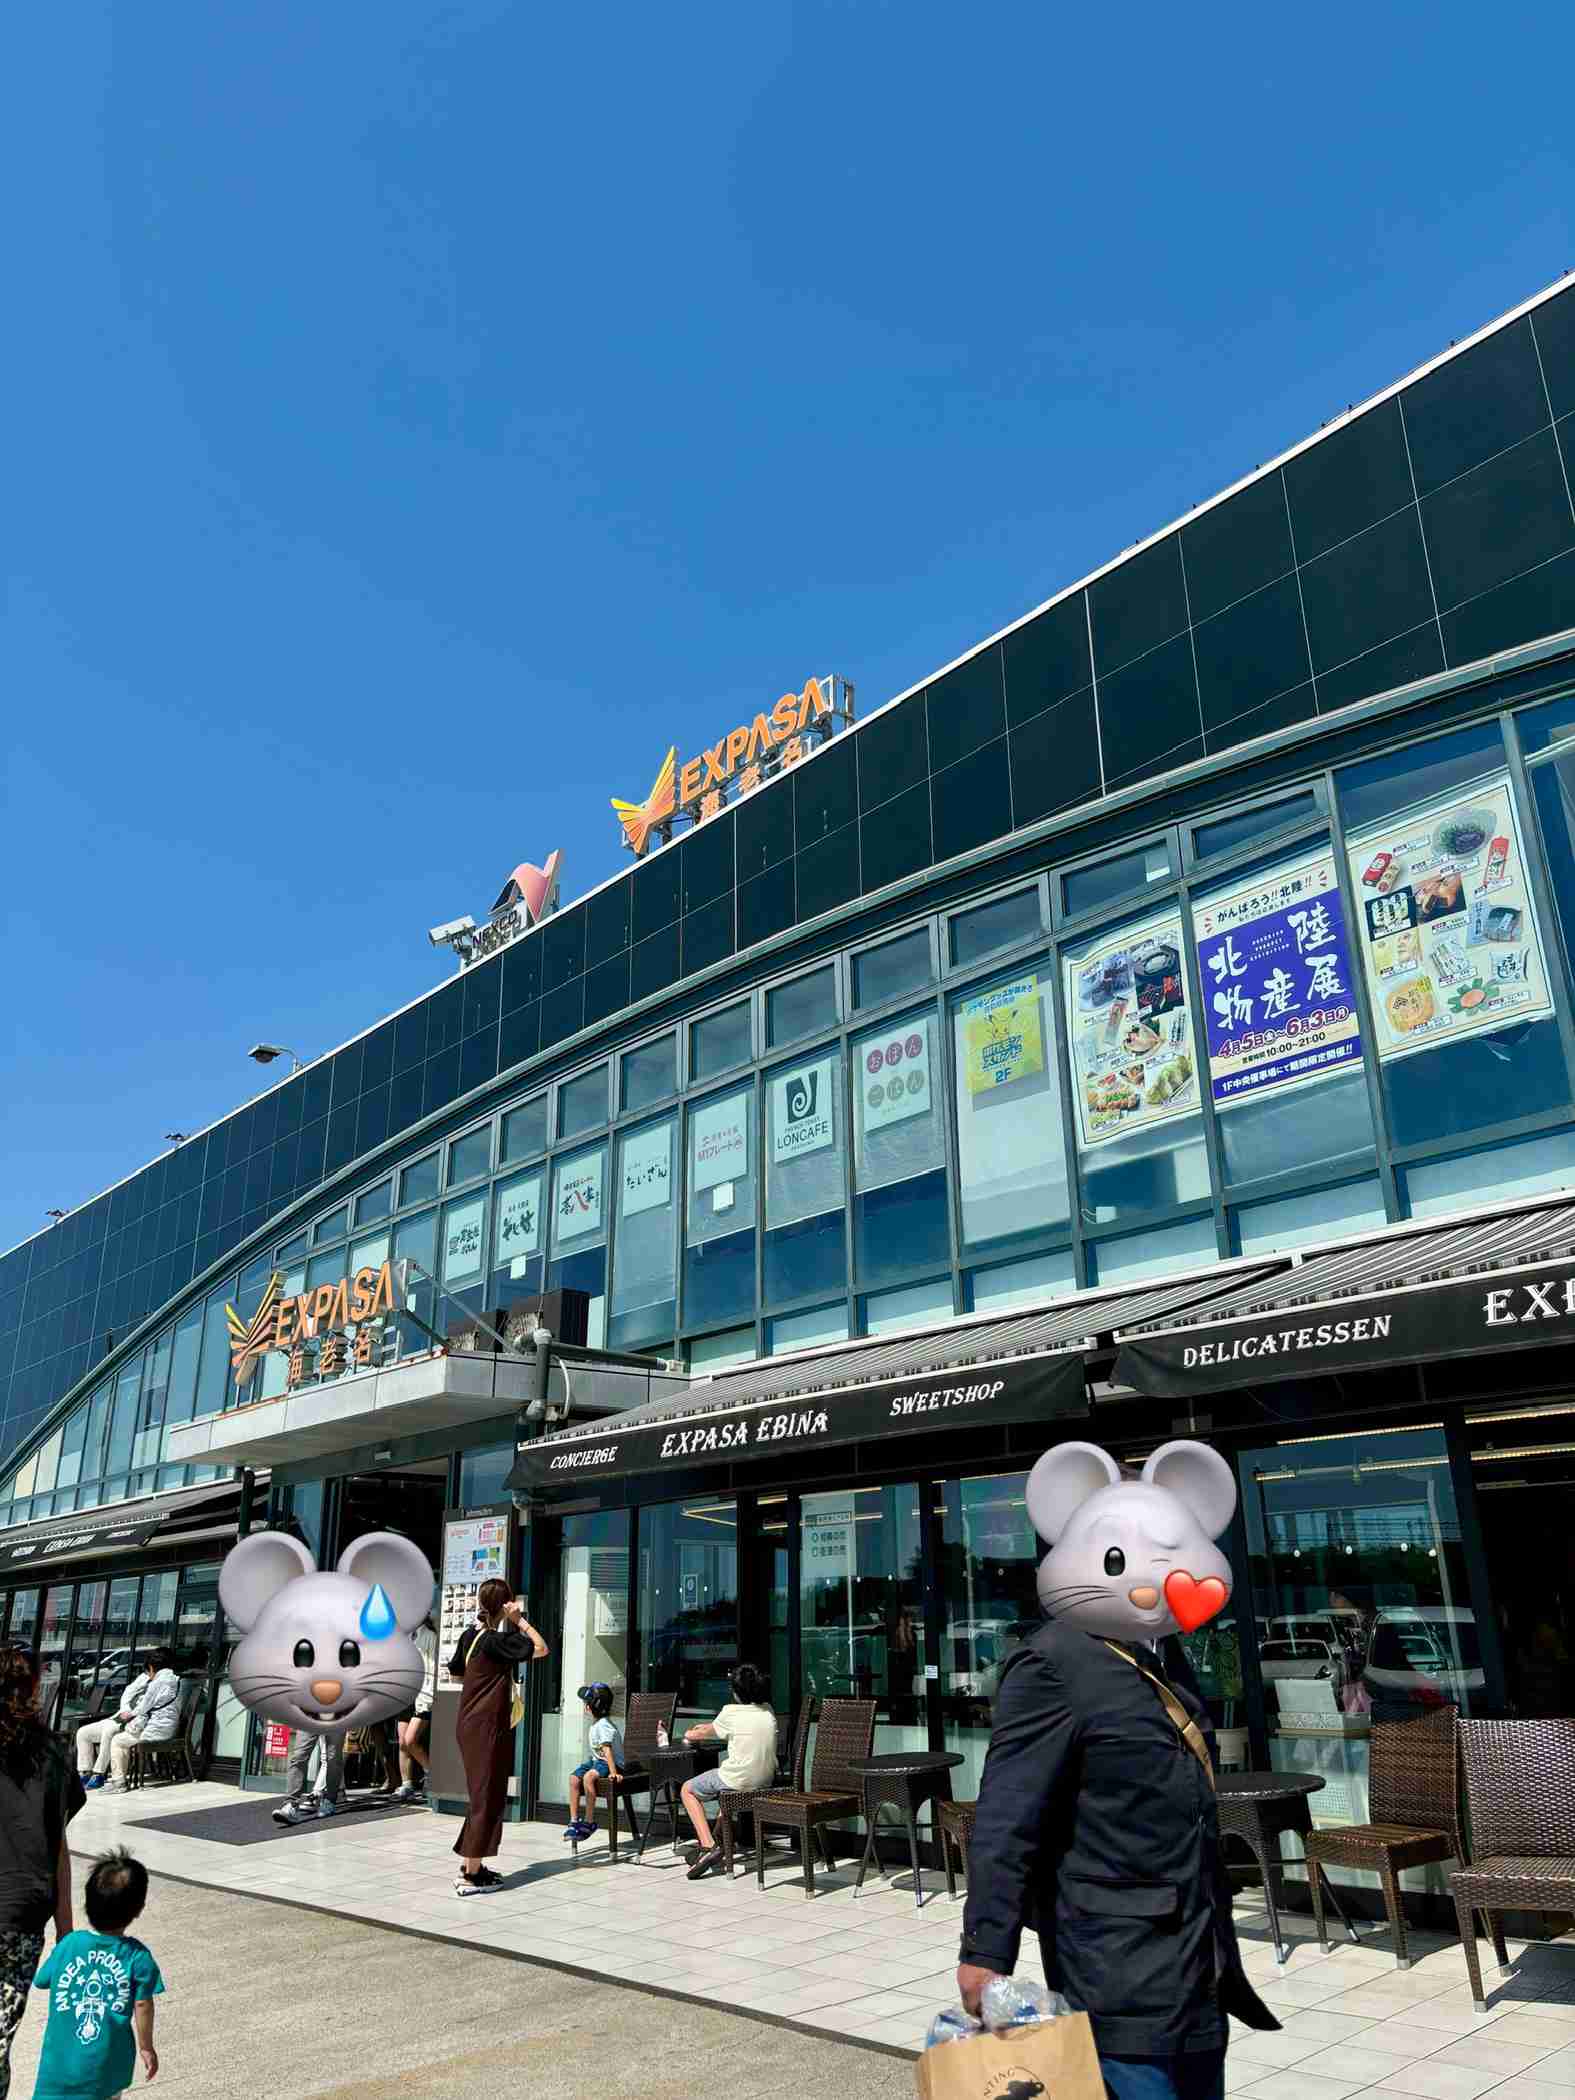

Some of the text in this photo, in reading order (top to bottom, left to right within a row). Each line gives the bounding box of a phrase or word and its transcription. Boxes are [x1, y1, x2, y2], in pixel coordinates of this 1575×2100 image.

[681, 677, 826, 806] EXPASA
[275, 1262, 394, 1347] EXPASA
[1183, 1314, 1393, 1370] DELICATESSEN
[889, 1380, 1005, 1417] SWEETSHOP
[550, 1445, 619, 1469] CONCIERGE
[660, 1408, 829, 1458] EXPASA EBINA
[55, 1950, 131, 2013] AN IDEA PRODUCING
